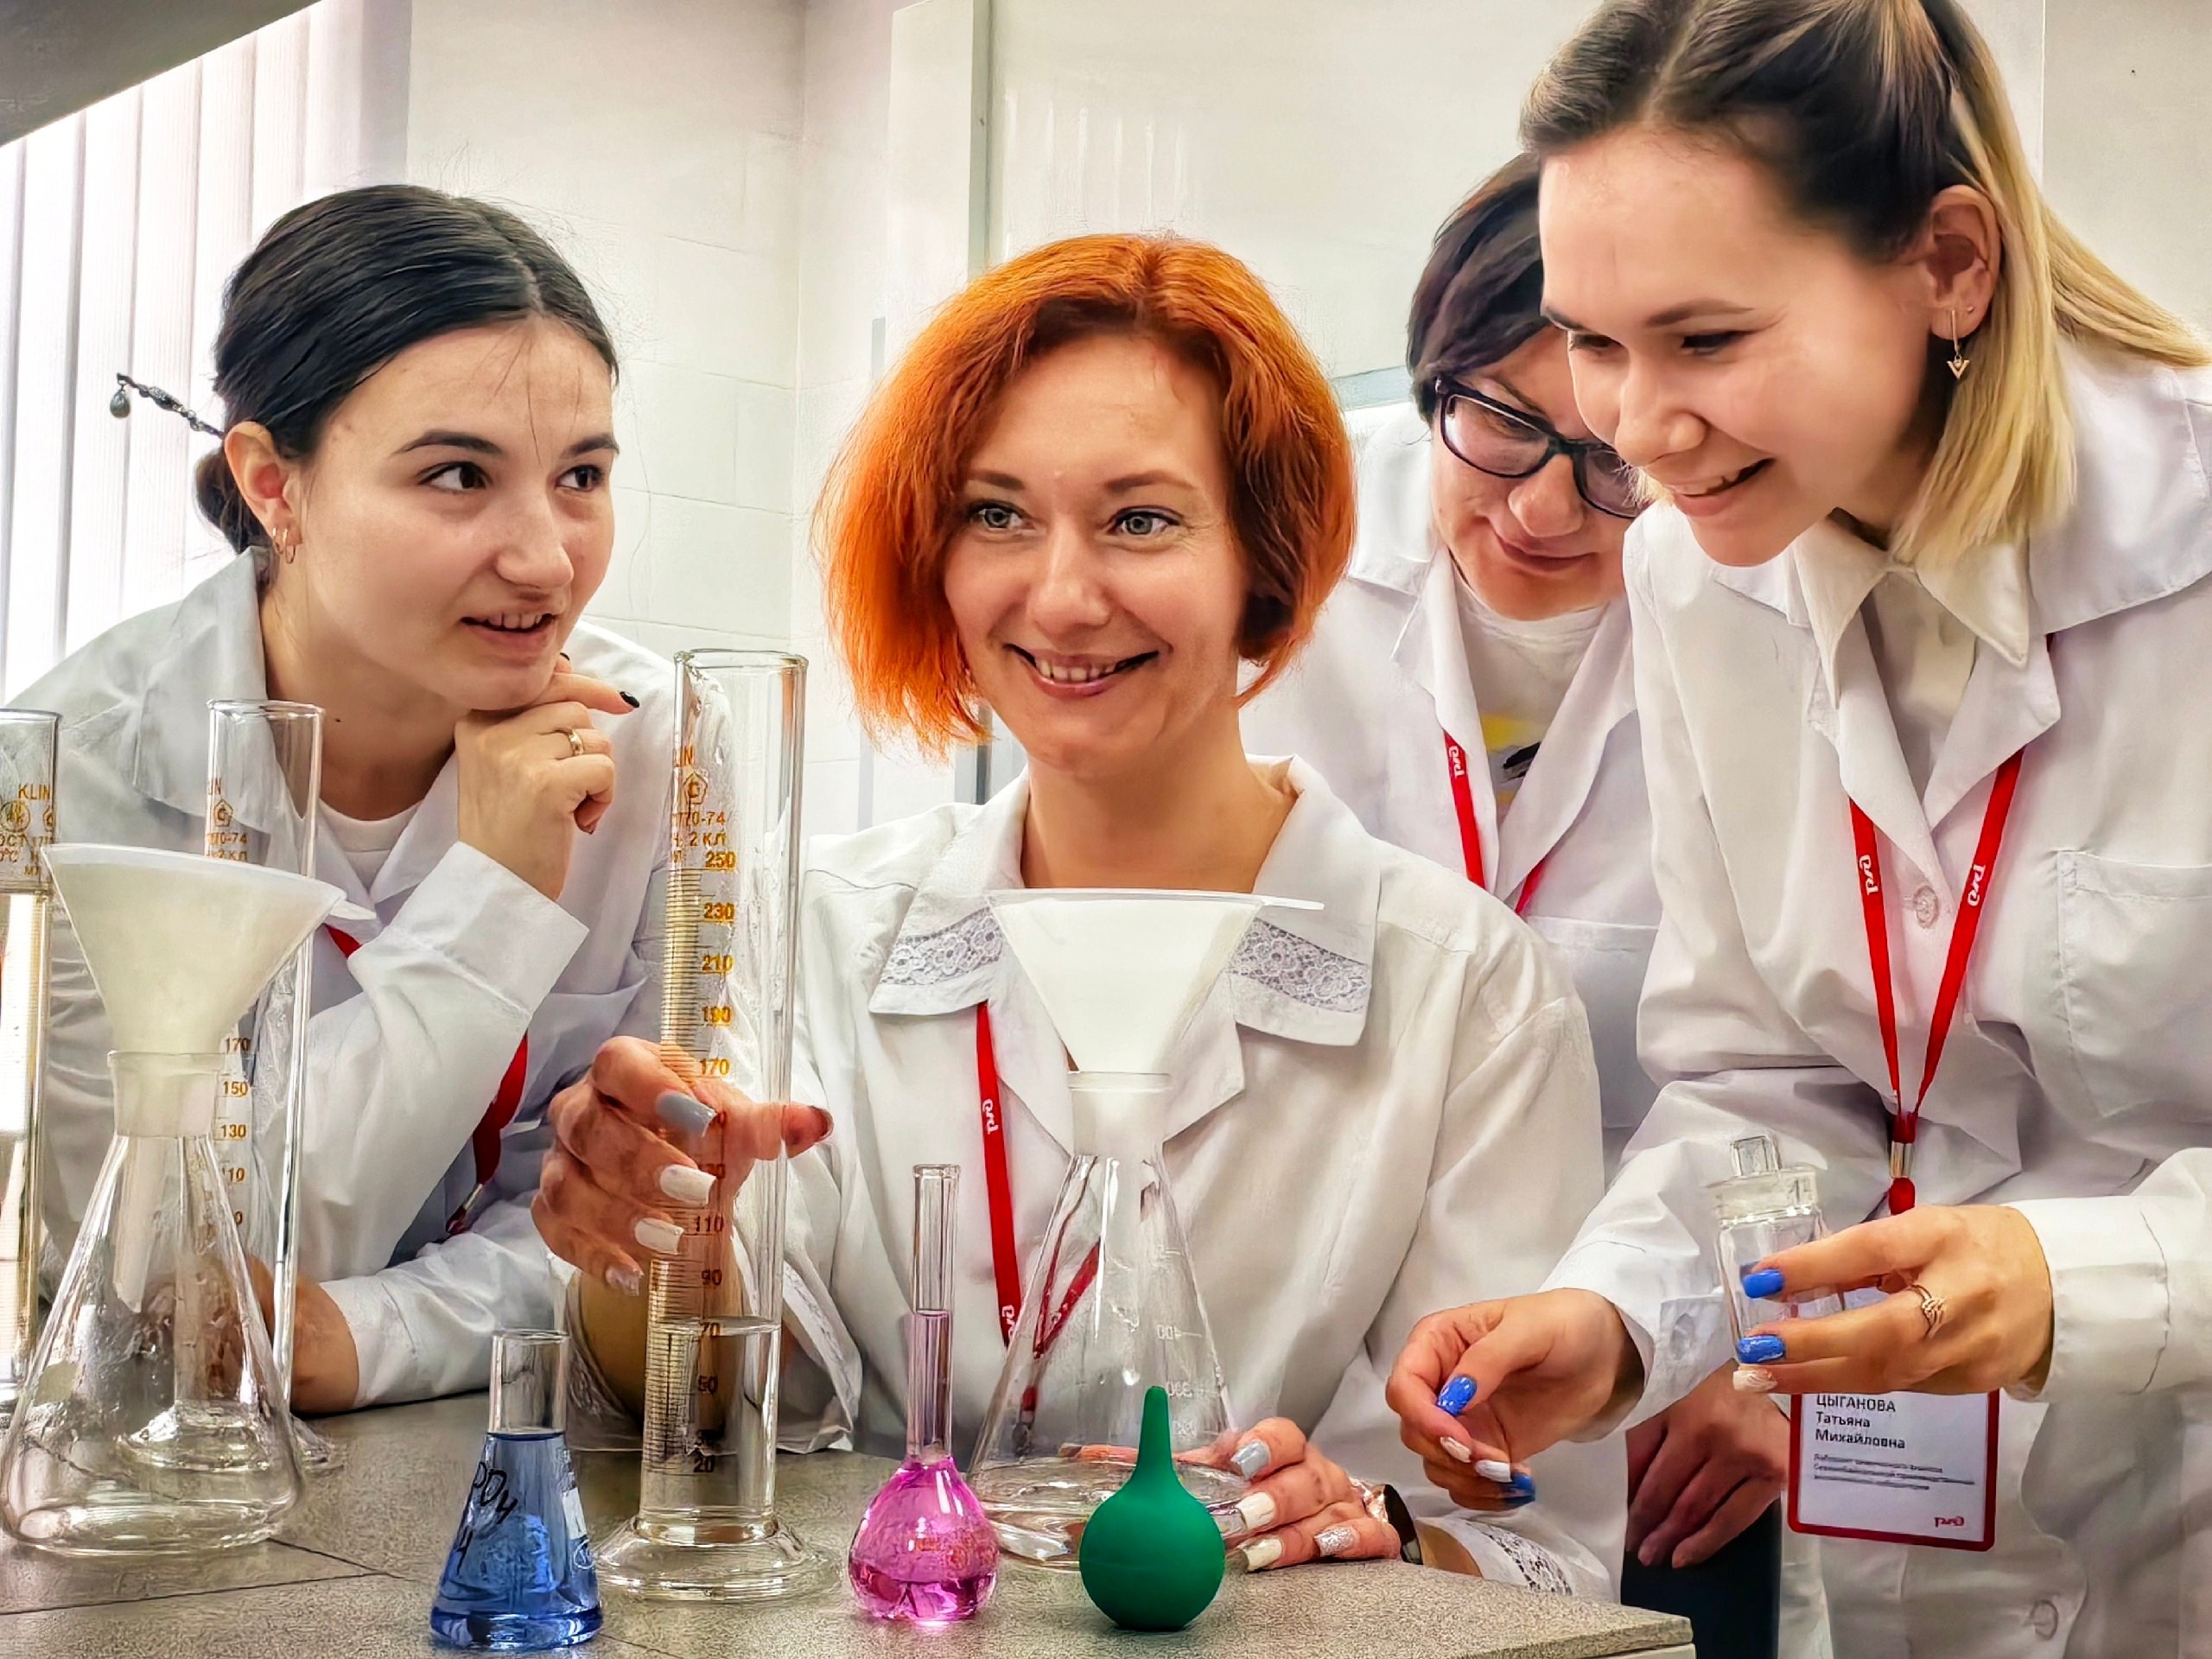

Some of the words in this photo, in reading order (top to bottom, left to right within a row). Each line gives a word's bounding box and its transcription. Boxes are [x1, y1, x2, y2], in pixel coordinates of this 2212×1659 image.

[705, 851, 736, 868] 250
[703, 903, 734, 920] 230
[702, 955, 733, 971] 210
[224, 1037, 251, 1053] 170
[701, 1058, 730, 1075] 170
[222, 1081, 249, 1096] 150
[220, 1124, 247, 1139] 130
[695, 1212, 724, 1233] 110
[701, 1268, 722, 1286] 90
[1816, 1394, 1897, 1413] ЦЫГАНОВА
[1816, 1411, 1871, 1427] Татьяна
[1815, 1428, 1906, 1449] Михайловна
